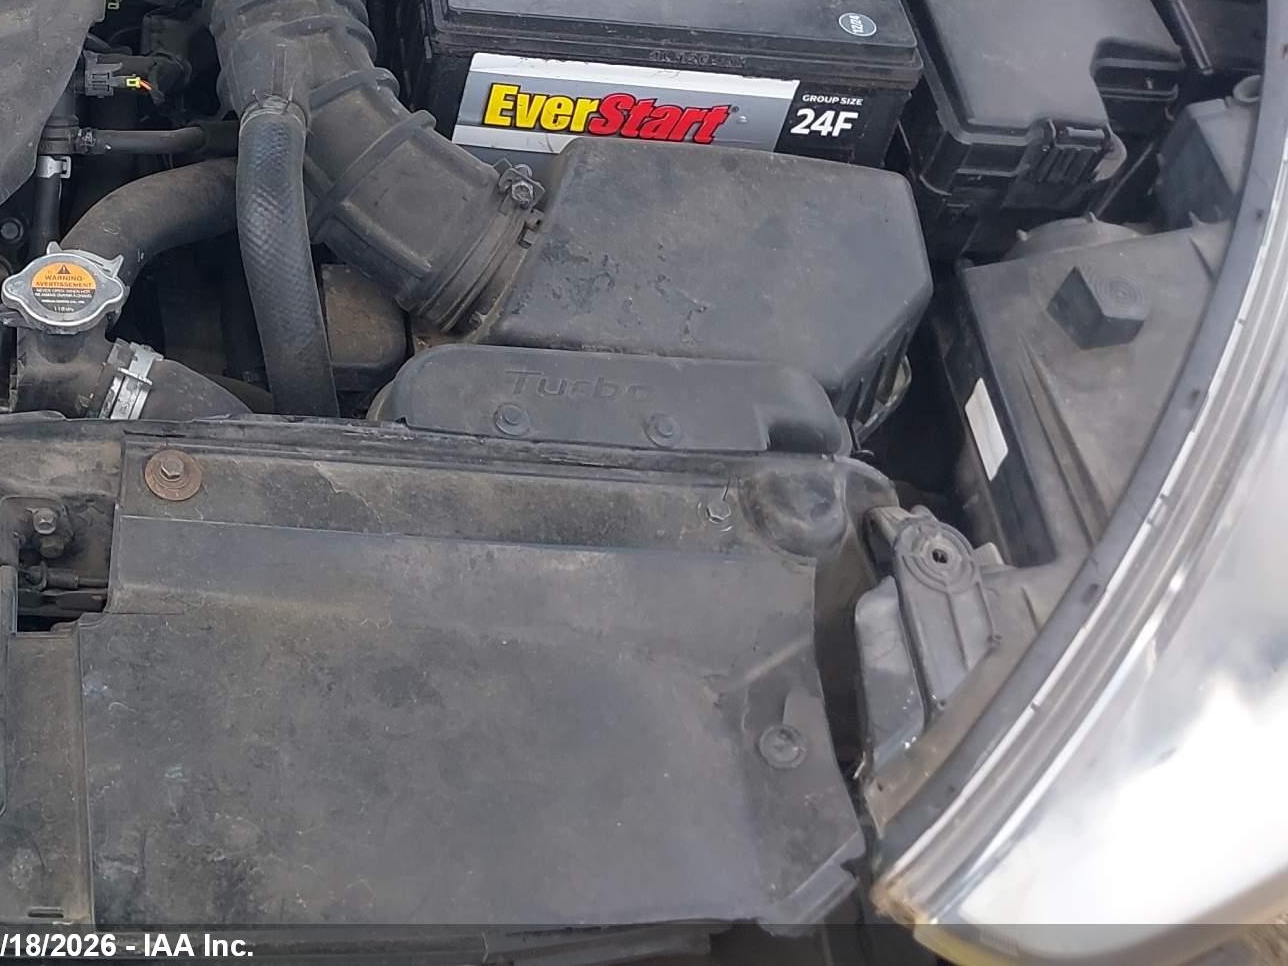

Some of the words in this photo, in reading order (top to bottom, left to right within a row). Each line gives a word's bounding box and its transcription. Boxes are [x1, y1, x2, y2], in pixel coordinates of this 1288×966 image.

[482, 82, 732, 144] EverStart
[802, 93, 839, 105] GROUP
[840, 97, 864, 107] SIZE
[790, 108, 859, 138] 24F
[504, 369, 655, 402] Turbo
